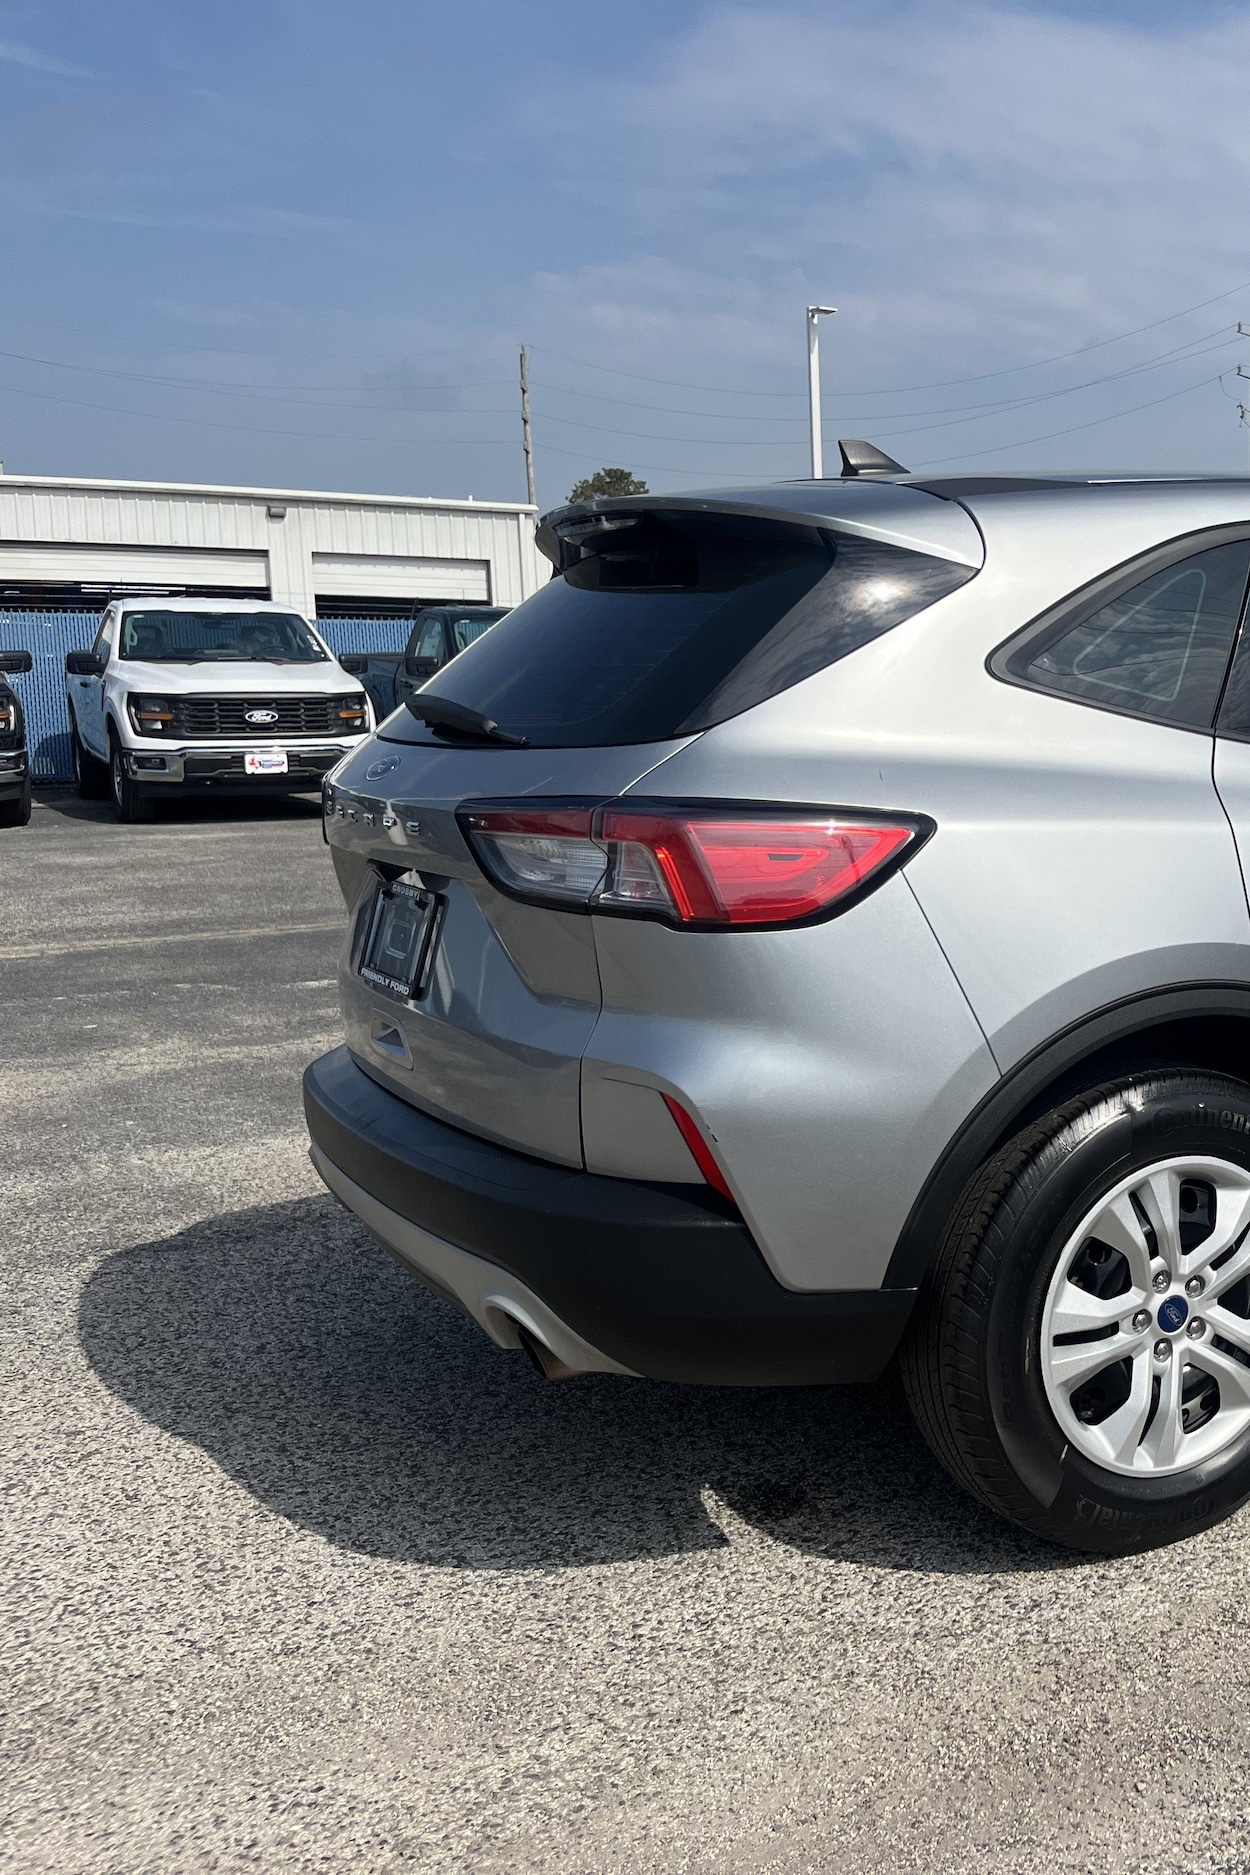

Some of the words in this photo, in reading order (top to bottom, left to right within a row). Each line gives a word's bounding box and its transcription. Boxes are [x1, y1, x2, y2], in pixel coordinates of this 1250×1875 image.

[392, 884, 418, 898] CROSBY
[361, 967, 390, 987] FRIENDLY
[390, 980, 410, 996] FORD
